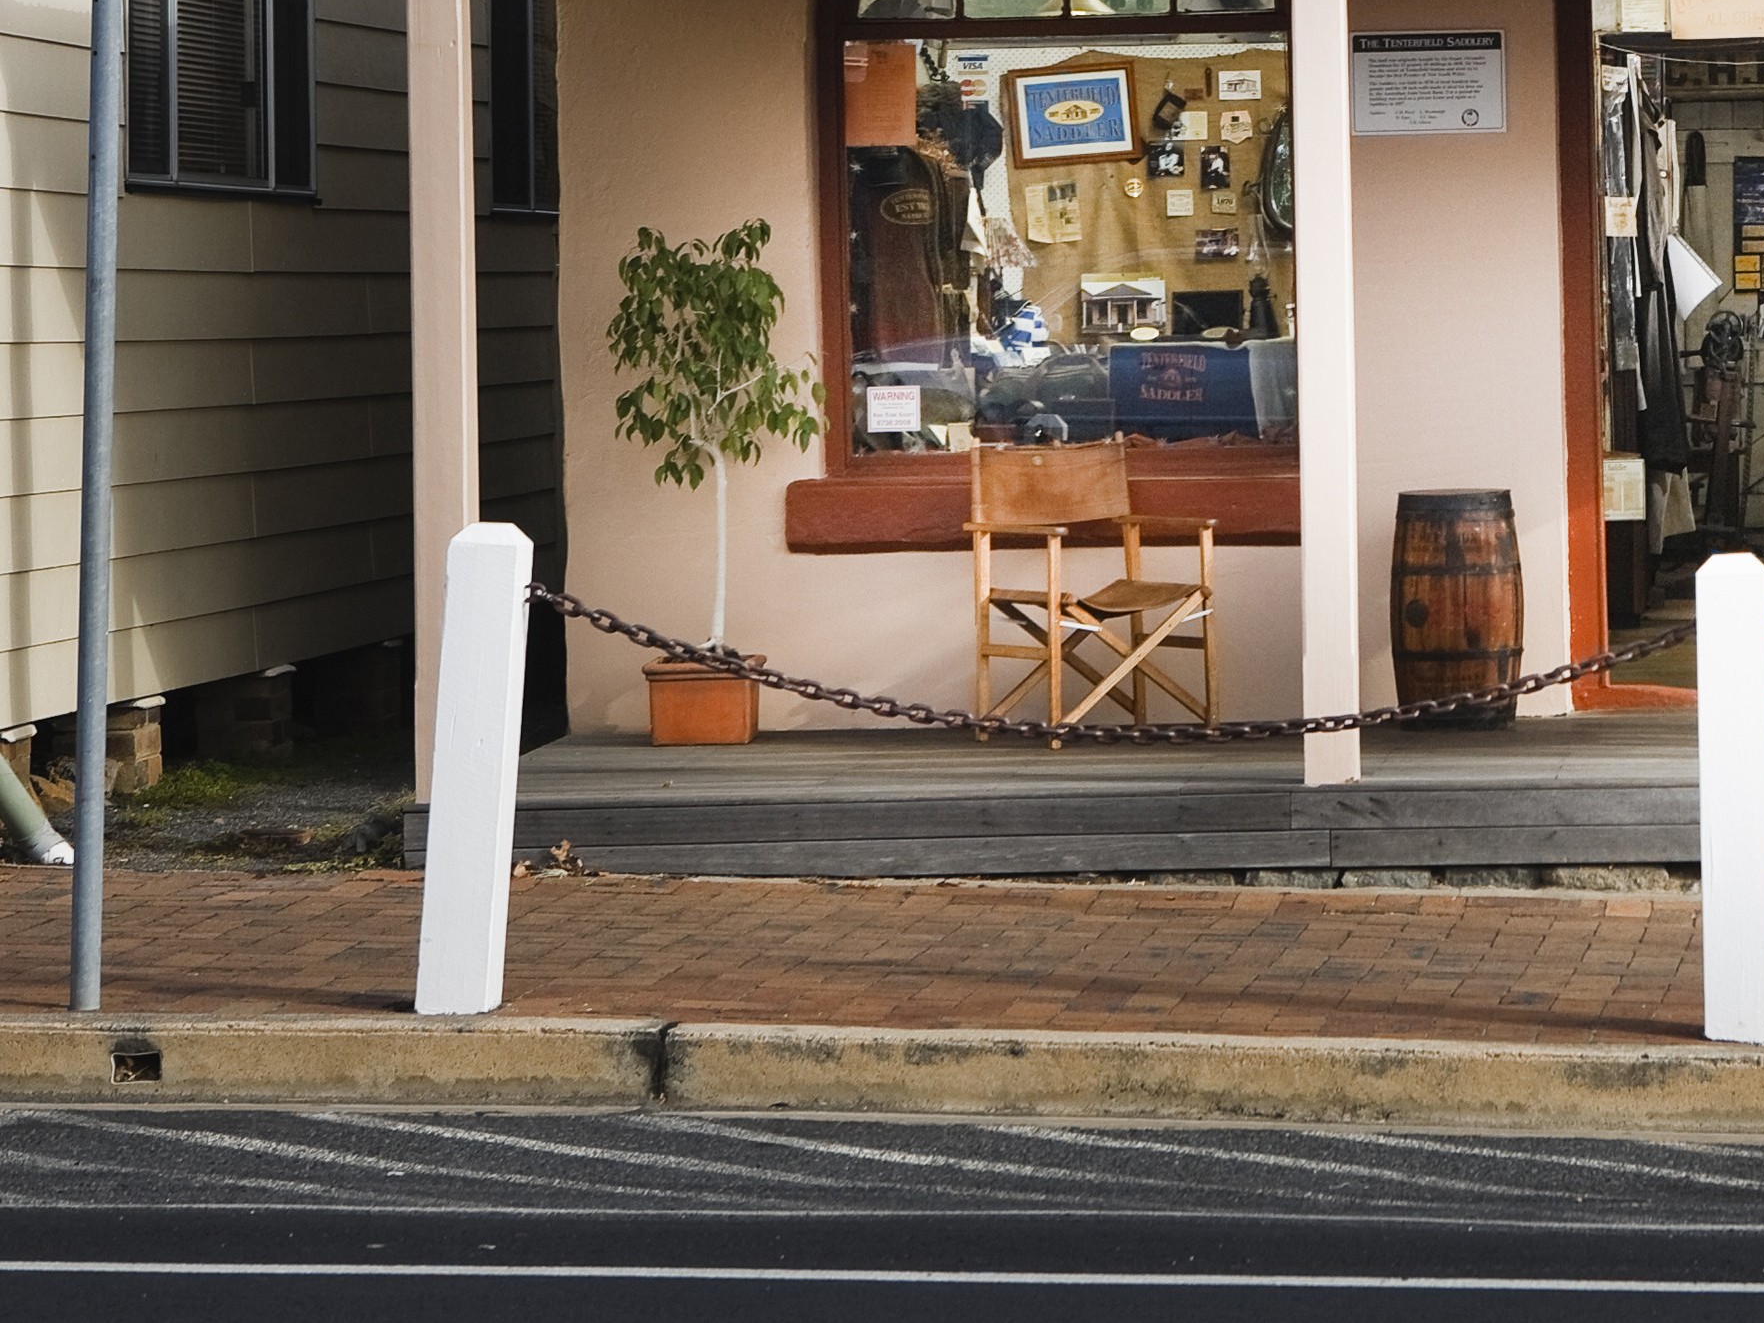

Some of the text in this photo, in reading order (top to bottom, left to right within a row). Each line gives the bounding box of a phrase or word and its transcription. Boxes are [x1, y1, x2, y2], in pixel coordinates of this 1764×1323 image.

[1359, 36, 1495, 49] THE TENTERFIELD SADDLERY
[1029, 84, 1120, 114] TENTERFIELD
[1032, 118, 1118, 144] SADDLER
[1139, 351, 1207, 373] TENTERFIELD
[872, 390, 916, 401] WARNING
[1140, 383, 1204, 402] SADDLER
